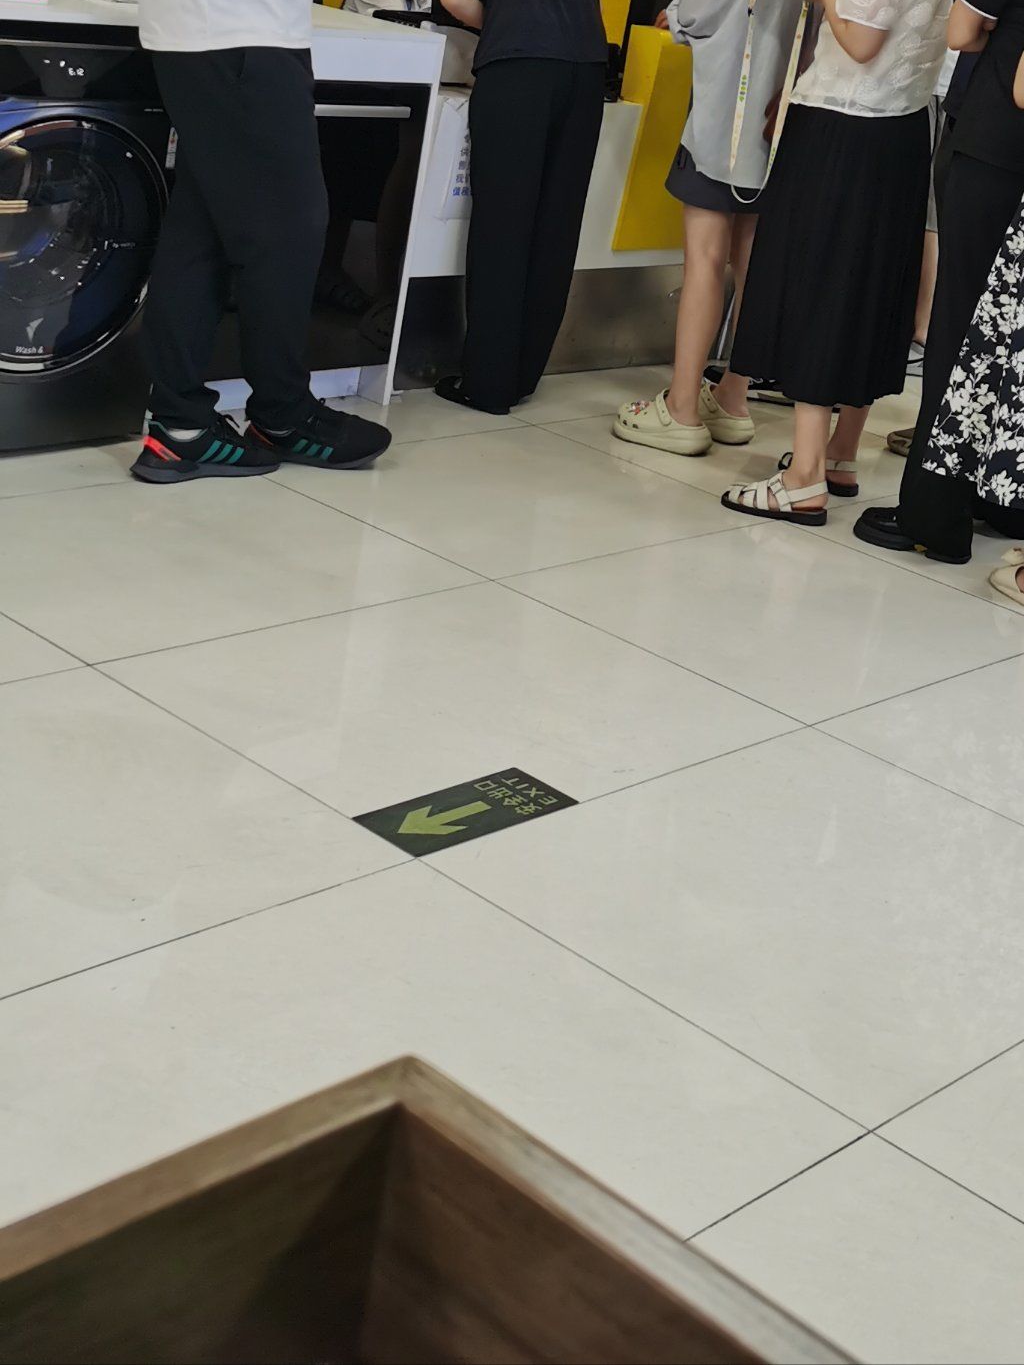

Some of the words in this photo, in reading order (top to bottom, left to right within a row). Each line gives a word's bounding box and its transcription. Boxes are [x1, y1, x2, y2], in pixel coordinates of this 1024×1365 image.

[473, 780, 543, 816] 安全出口
[501, 777, 558, 806] EXIT
